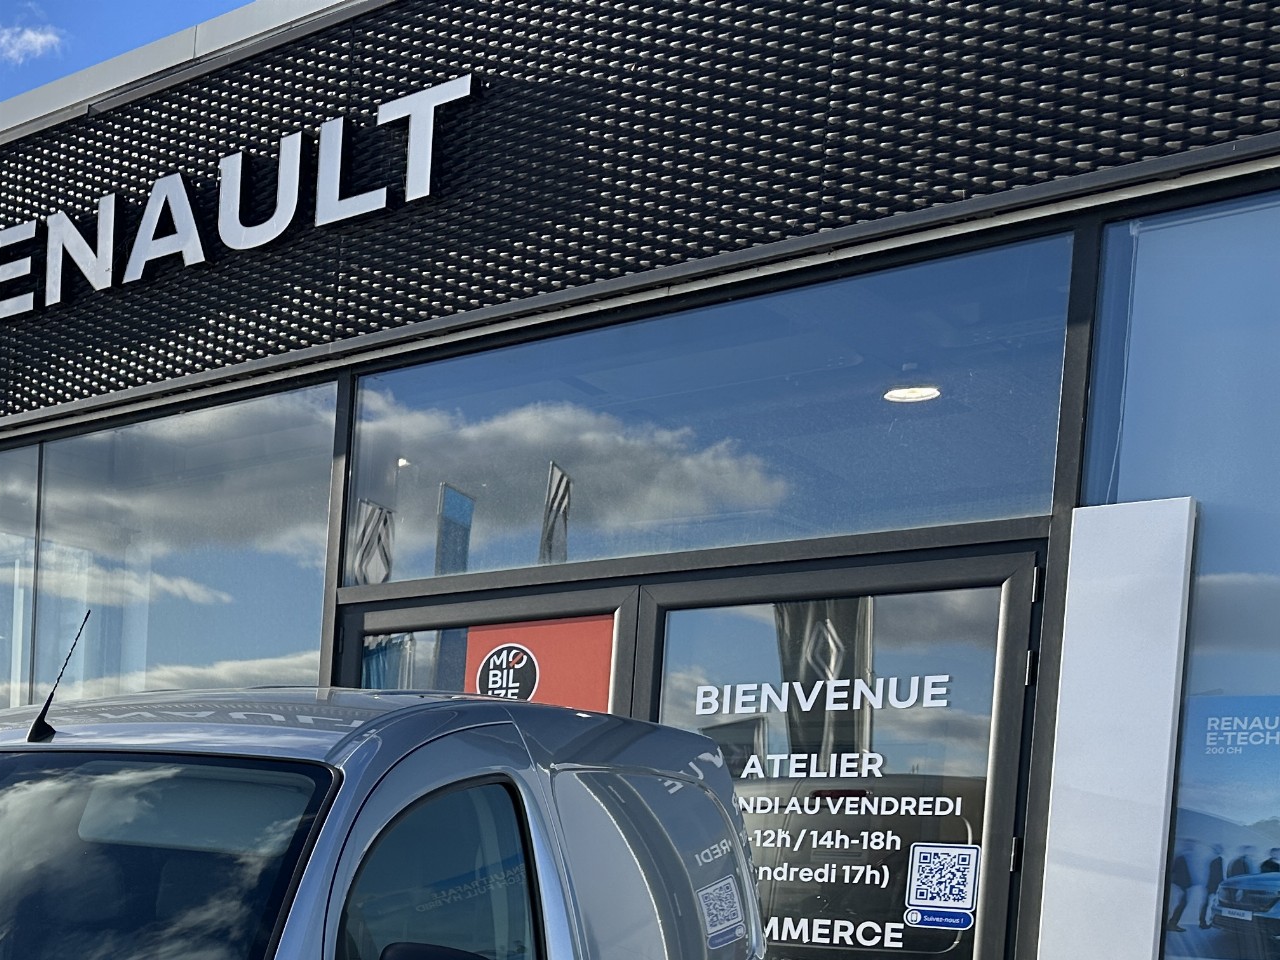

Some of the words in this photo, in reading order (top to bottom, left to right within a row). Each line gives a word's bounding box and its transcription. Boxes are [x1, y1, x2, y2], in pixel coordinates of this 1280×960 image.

[488, 668, 520, 689] BIL
[695, 674, 951, 716] BIENVENUE
[1207, 716, 1280, 731] RENAU
[1206, 732, 1280, 746] E-TECH
[1205, 746, 1225, 755] 200
[1226, 746, 1242, 754] CH
[740, 752, 884, 778] ATELIER
[738, 796, 780, 814] NDI
[784, 796, 820, 815] AU
[825, 796, 962, 816] VENDREDI
[757, 862, 837, 883] ndredi
[842, 864, 891, 889] 17h)
[764, 916, 905, 948] MMERCE
